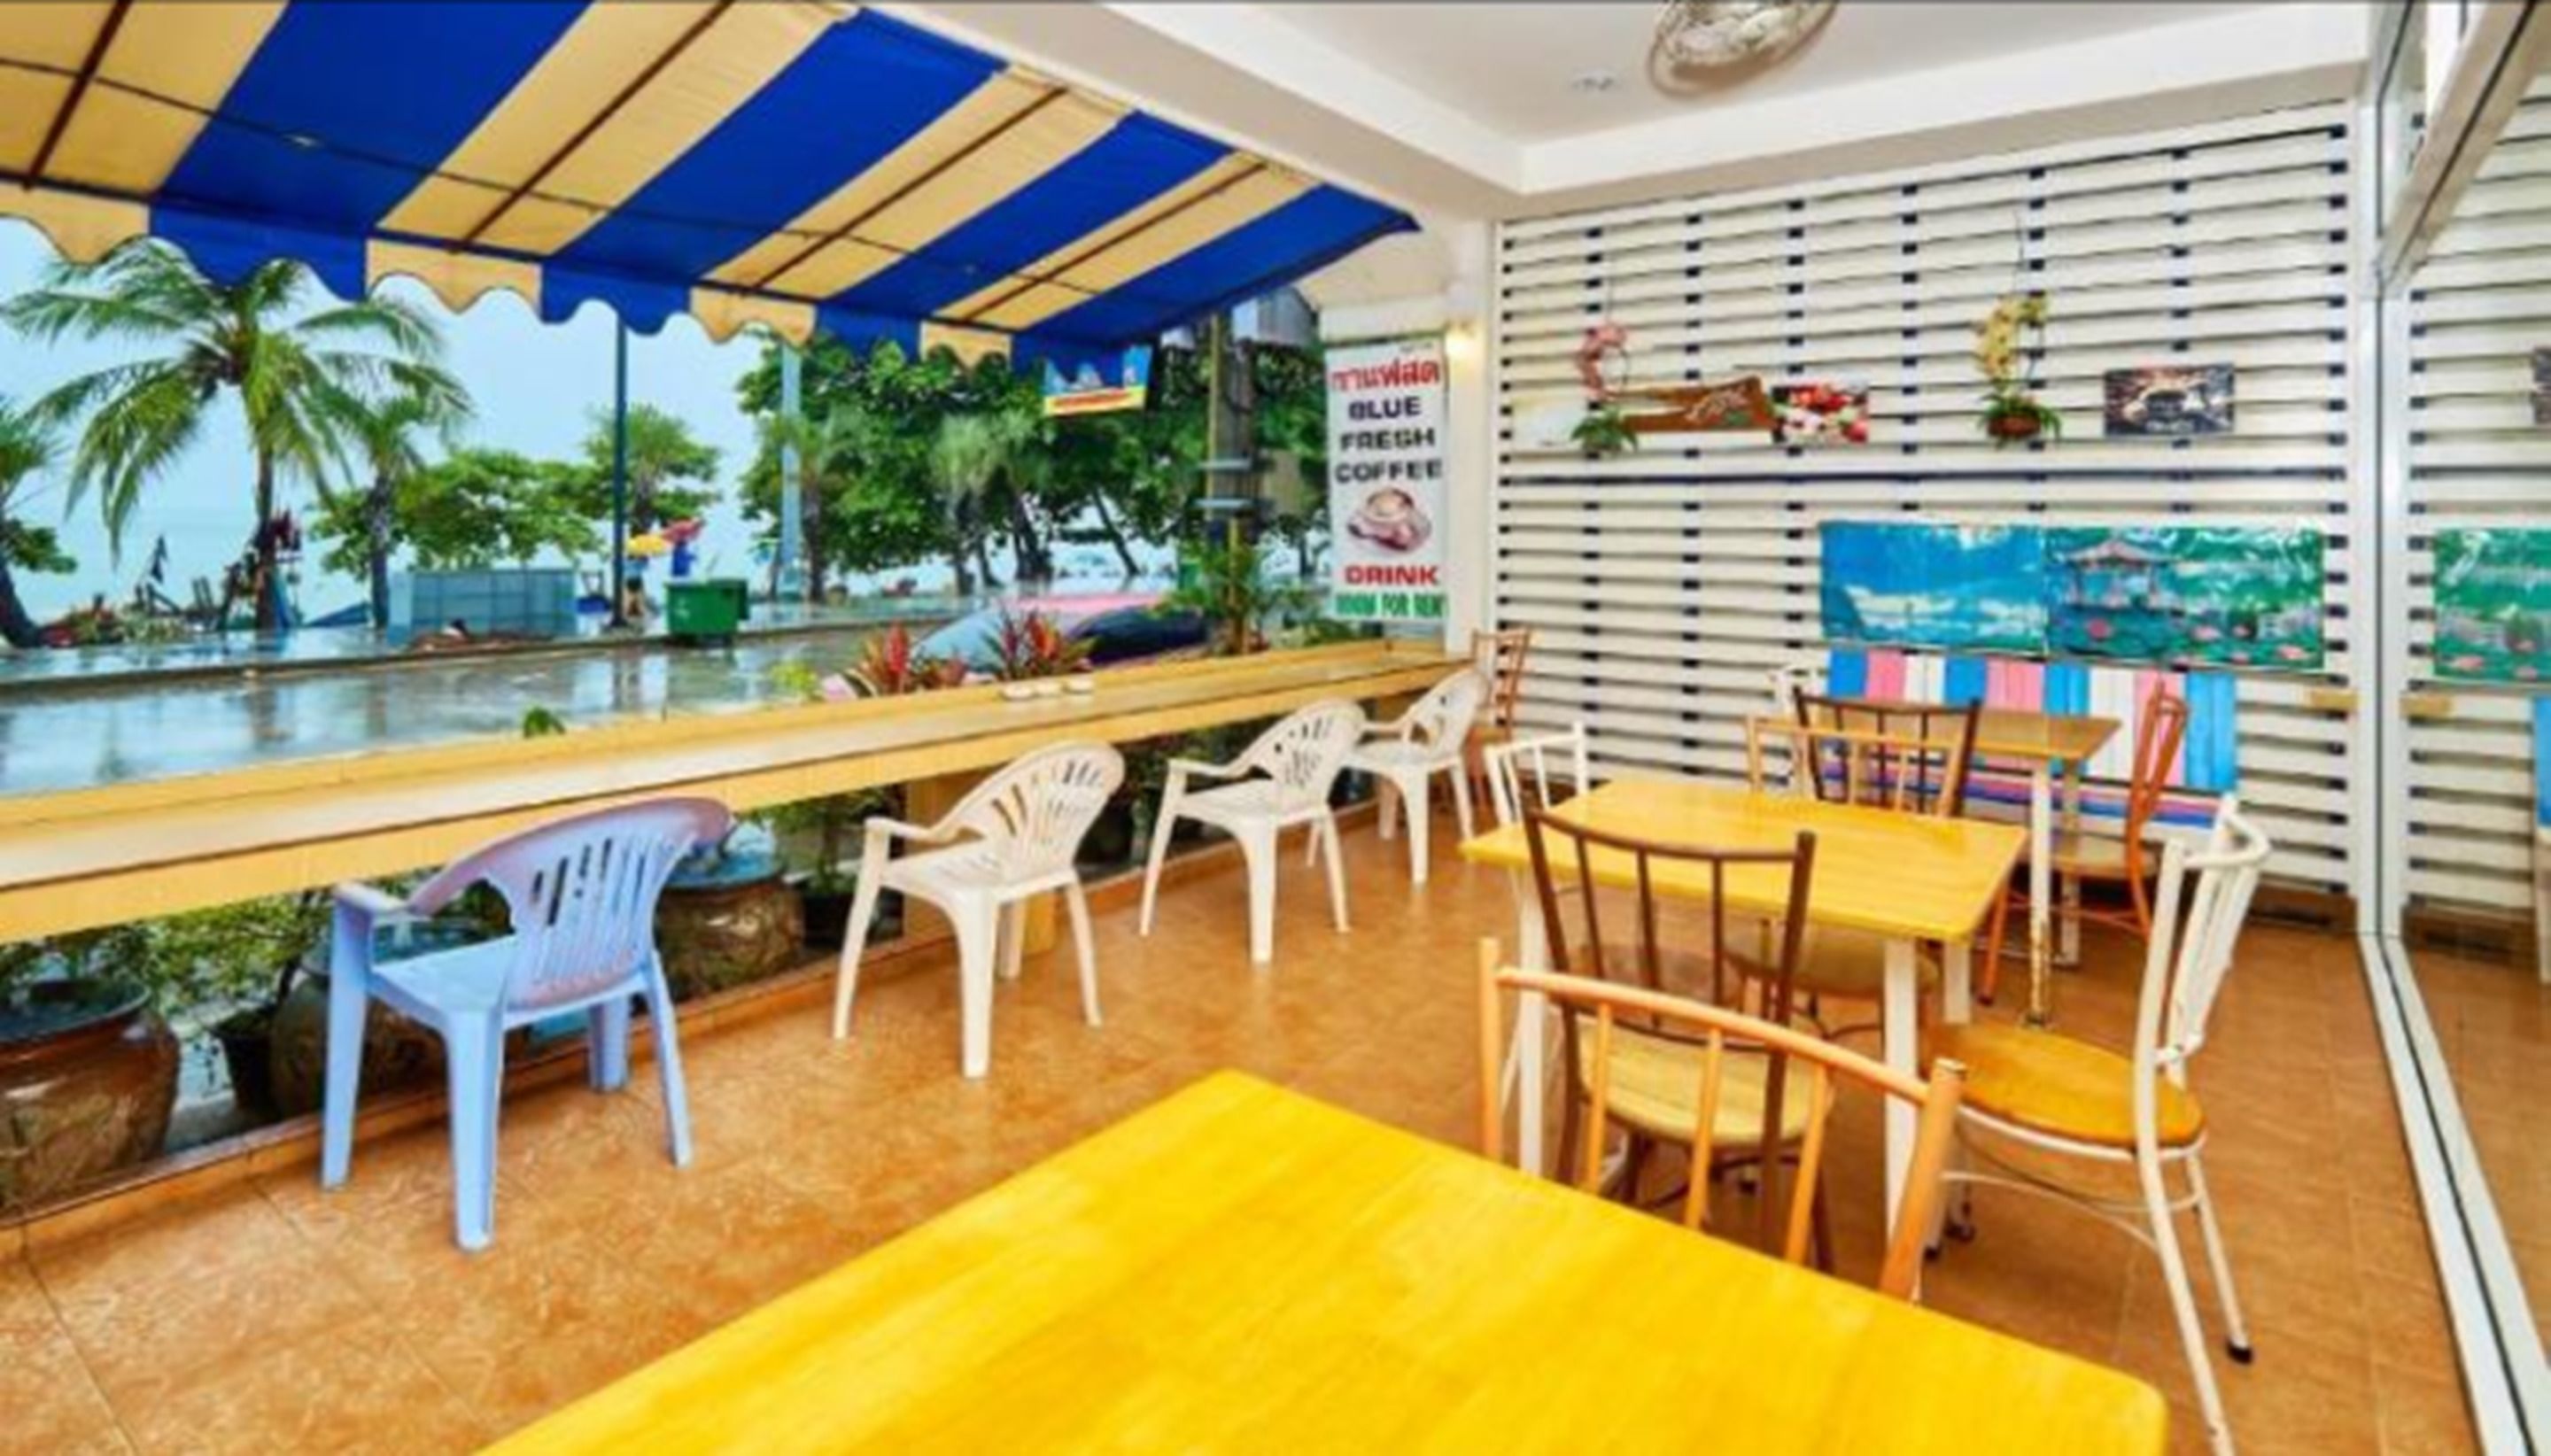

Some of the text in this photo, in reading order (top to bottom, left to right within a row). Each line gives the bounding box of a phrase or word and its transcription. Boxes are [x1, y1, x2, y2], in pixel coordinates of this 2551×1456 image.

[1349, 396, 1421, 420] BLUE
[1341, 429, 1434, 451] FRESH
[1335, 460, 1441, 483] COFFEE
[1345, 565, 1438, 585] DRINK
